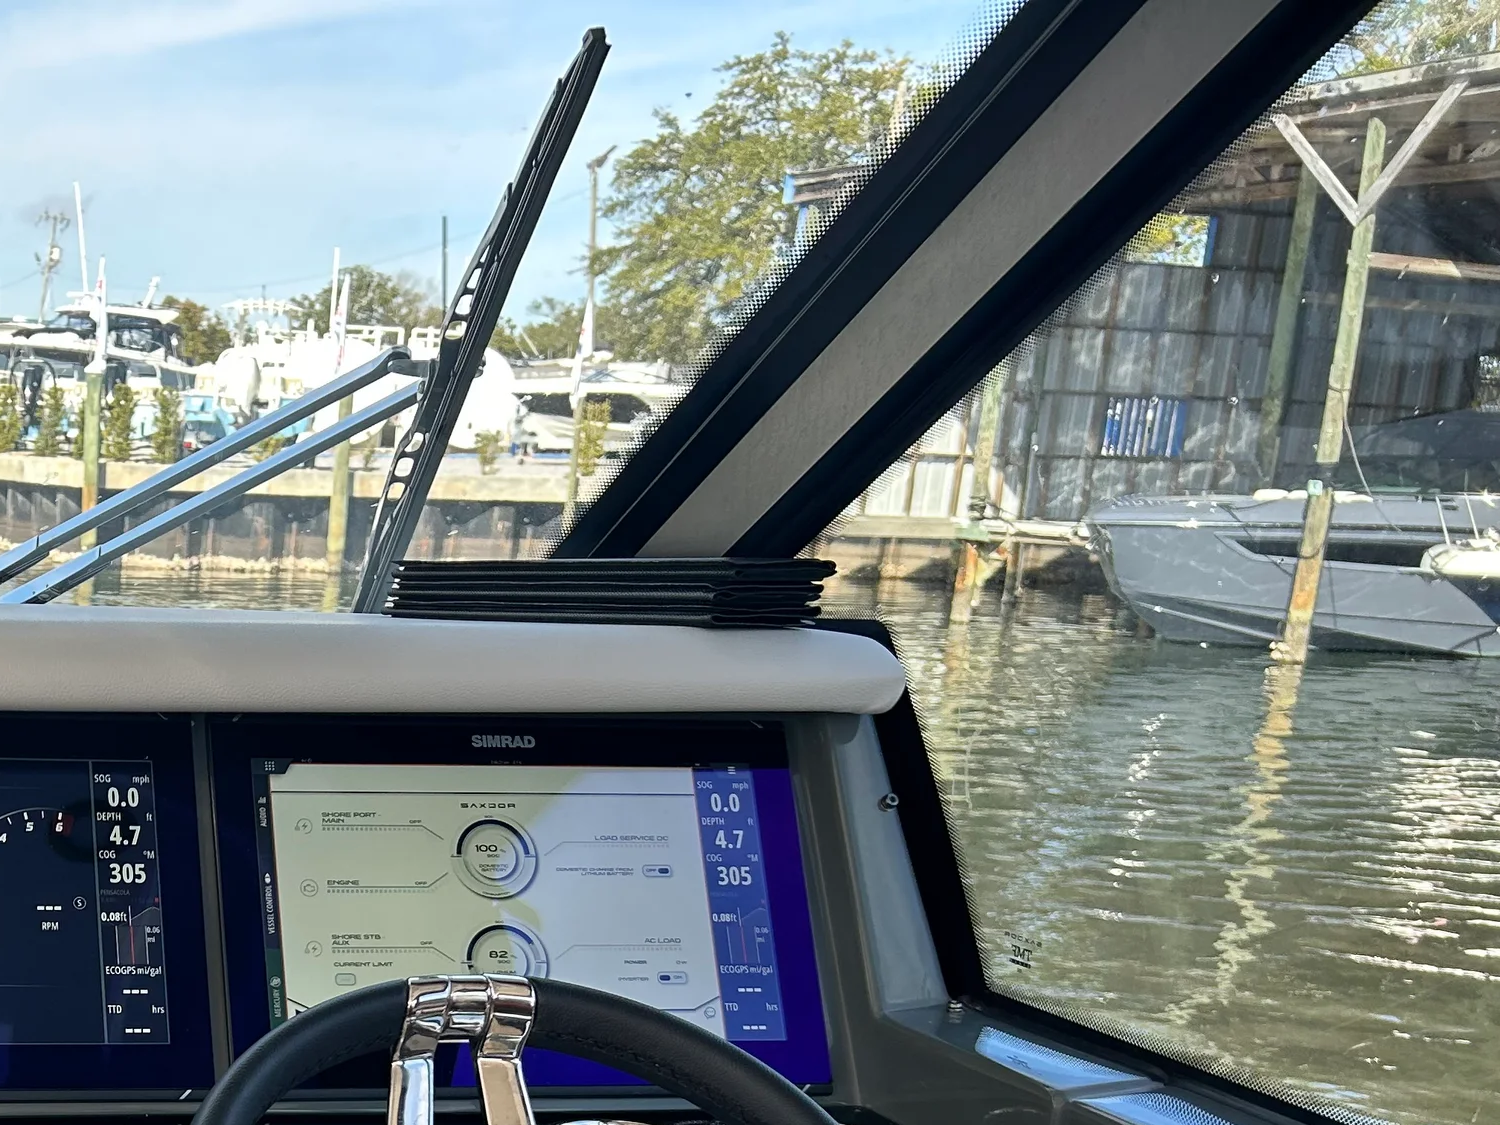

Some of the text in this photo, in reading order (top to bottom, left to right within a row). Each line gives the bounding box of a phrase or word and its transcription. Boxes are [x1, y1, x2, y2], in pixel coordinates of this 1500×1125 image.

[472, 735, 535, 748] SIMRAD
[94, 774, 149, 785] SOG mph
[108, 787, 139, 807] 0.0
[711, 794, 740, 812] 0.0
[97, 812, 152, 821] DEPTH ft
[110, 825, 140, 845] 4.7
[715, 830, 743, 848] 4.7
[475, 844, 498, 852] 100
[99, 850, 116, 858] COG
[110, 863, 146, 883] 305
[717, 867, 751, 885] 305
[42, 922, 58, 931] RPM
[106, 966, 161, 977] ECOGPS mi/gal
[720, 965, 748, 973] ECOGPS
[108, 1005, 164, 1013] TTD hrs
[725, 1003, 738, 1011] TTD
